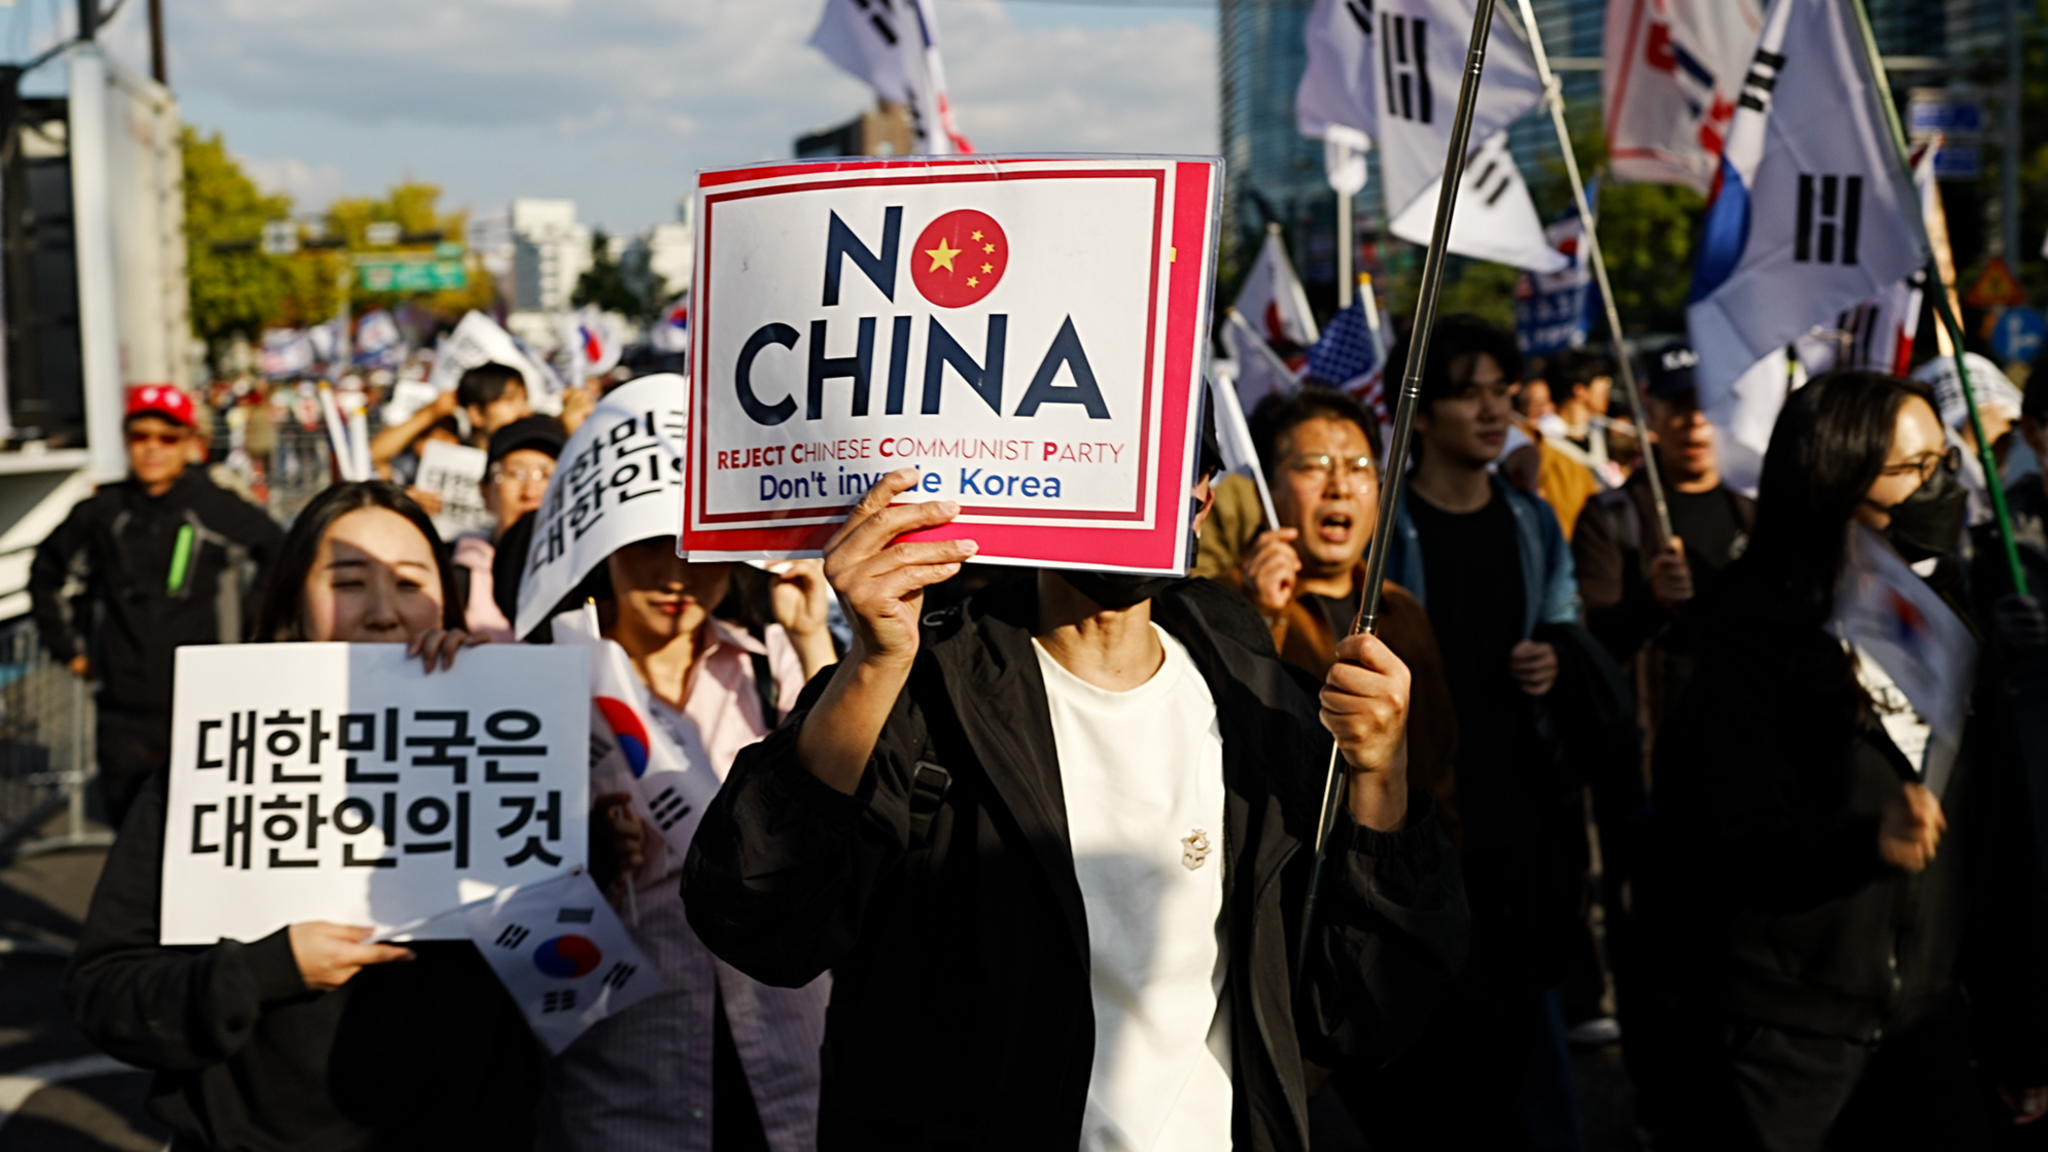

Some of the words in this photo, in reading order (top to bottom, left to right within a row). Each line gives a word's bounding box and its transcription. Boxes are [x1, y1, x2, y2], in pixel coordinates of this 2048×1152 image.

[735, 313, 1112, 426] CHINA
[534, 411, 684, 528] 한민
[717, 446, 785, 469] REJECT
[791, 438, 871, 464] CHINESE
[879, 437, 1034, 461] COMMUNIST
[1043, 441, 1125, 464] PARTY
[760, 470, 827, 501] Don't
[839, 465, 942, 496] inve
[959, 468, 1062, 498] Korea
[530, 455, 684, 577] 대한인
[196, 708, 548, 784] 대한민국은
[190, 792, 470, 870] 대한인의
[496, 791, 563, 868] 것
